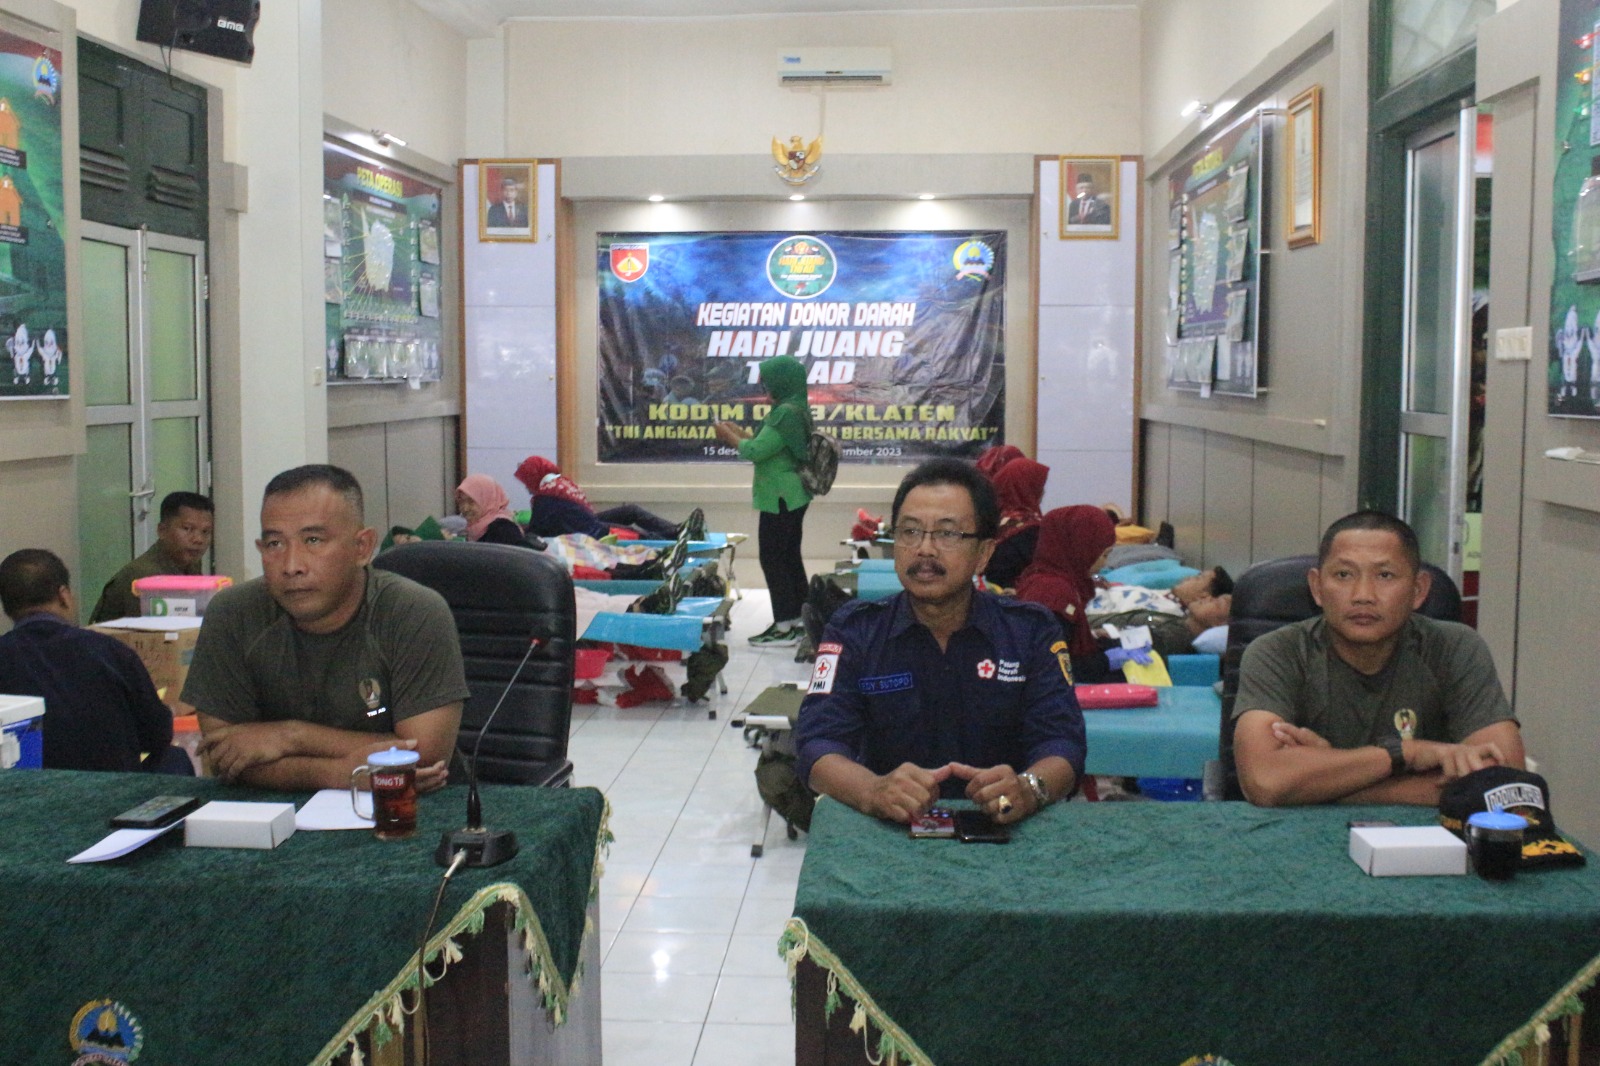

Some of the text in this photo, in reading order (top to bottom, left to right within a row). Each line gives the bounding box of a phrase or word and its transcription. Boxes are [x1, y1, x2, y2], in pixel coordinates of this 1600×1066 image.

[697, 302, 916, 326] KEGIATAN DONOR DARAH
[707, 330, 905, 357] HARI JUANG
[806, 360, 856, 384] AD
[649, 403, 955, 421] KODIM 03/KLATEN
[643, 425, 717, 439] ANGKATA
[842, 426, 921, 440] BERSAMA
[703, 446, 716, 456] 15
[876, 447, 902, 457] 2023
[812, 681, 826, 690] PMI
